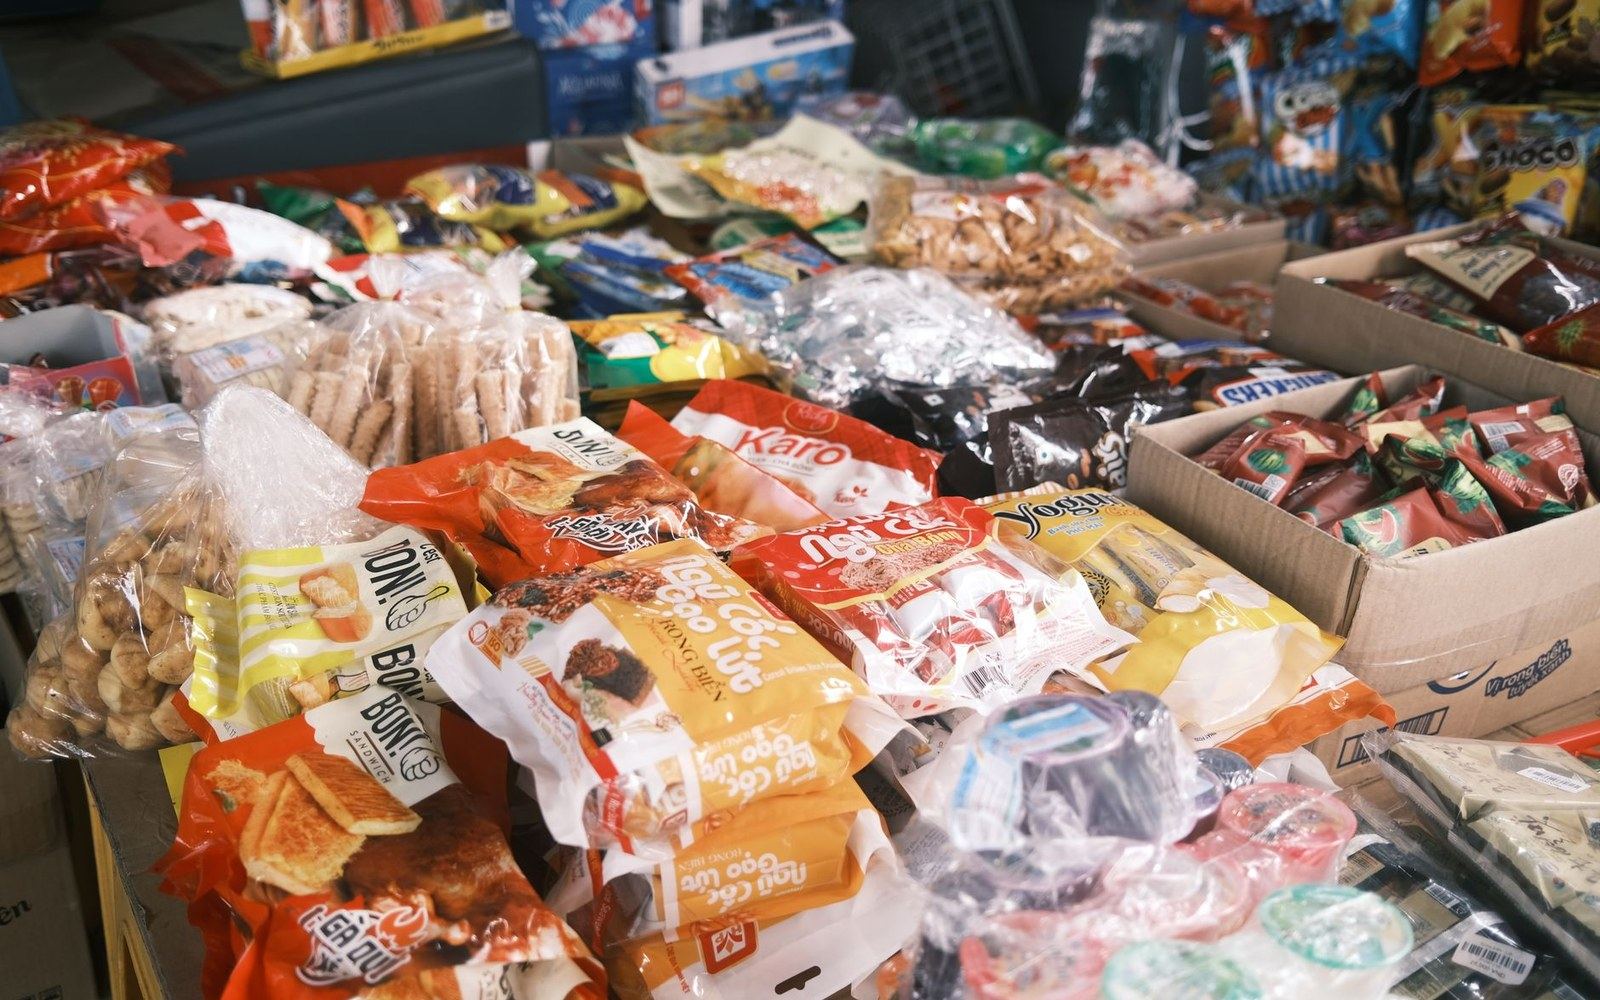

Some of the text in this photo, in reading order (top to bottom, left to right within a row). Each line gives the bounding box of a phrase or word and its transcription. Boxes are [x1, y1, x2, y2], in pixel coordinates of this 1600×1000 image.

[735, 428, 851, 467] Karo
[716, 602, 798, 650] Cốc
[657, 615, 697, 672] RONG
[689, 660, 728, 705] BIỂN
[706, 637, 765, 694] Lứt
[1501, 666, 1537, 689] rong
[1537, 638, 1569, 669] biển
[361, 694, 425, 759] BON!
[349, 729, 392, 786] SANDWICH
